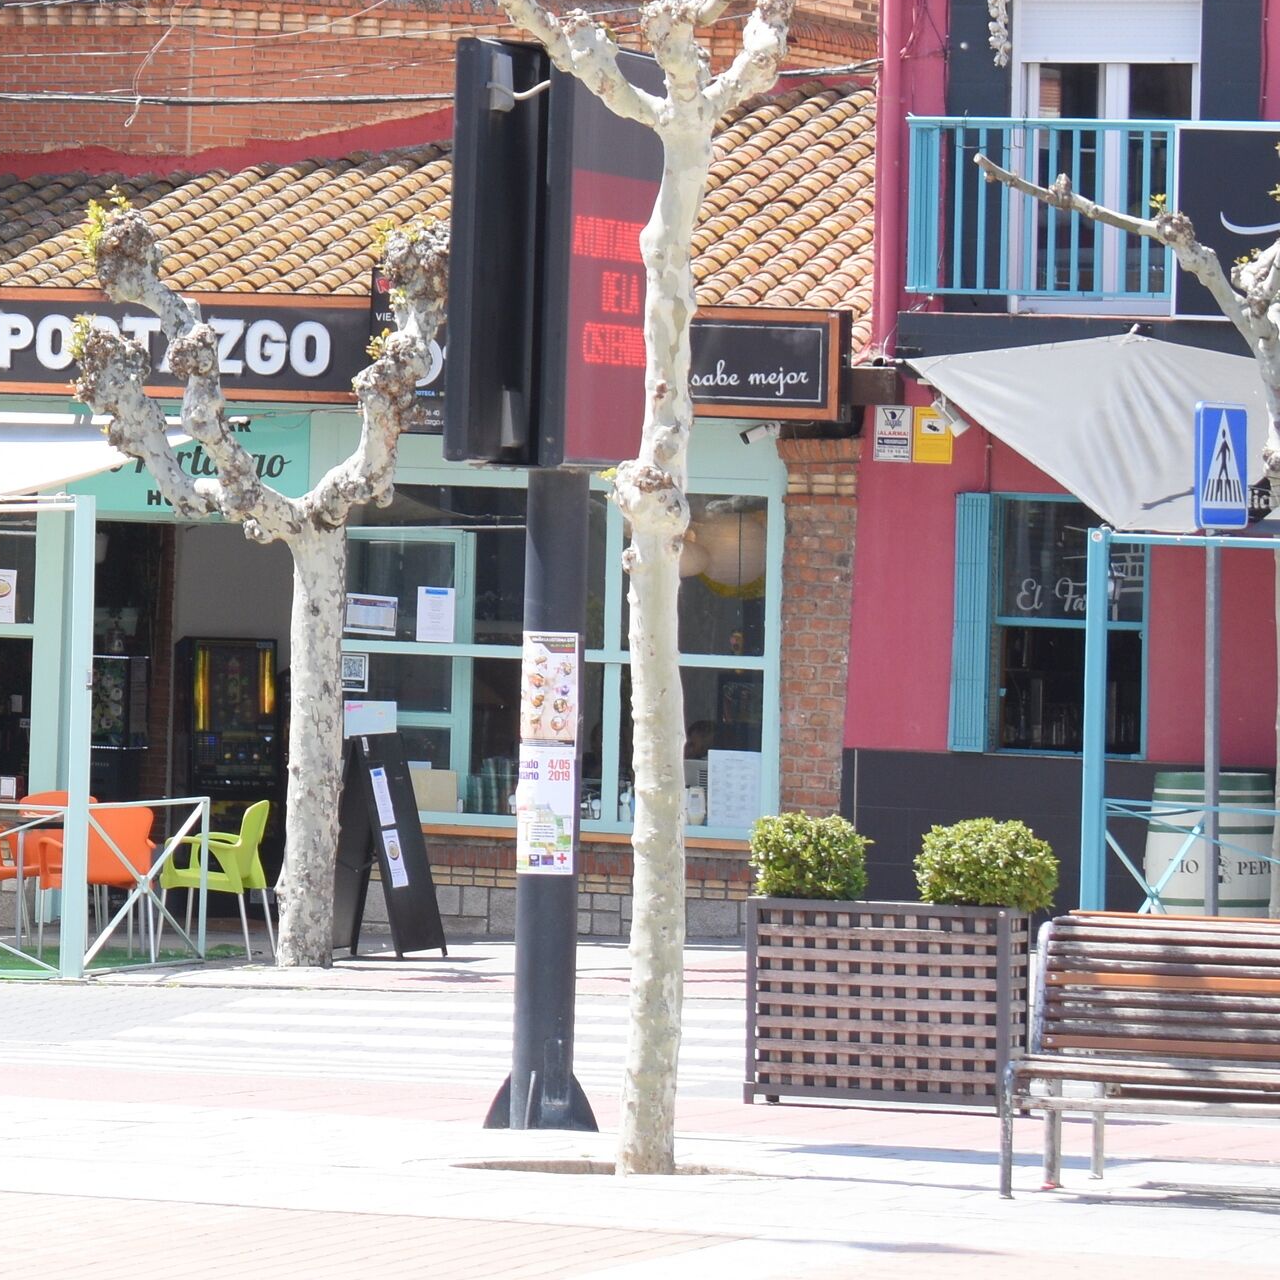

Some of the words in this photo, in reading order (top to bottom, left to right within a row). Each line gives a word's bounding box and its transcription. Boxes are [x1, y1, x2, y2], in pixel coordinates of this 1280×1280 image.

[691, 360, 740, 386] sabe
[748, 366, 809, 396] mejor
[1016, 578, 1043, 610] El
[547, 770, 570, 782] 2019
